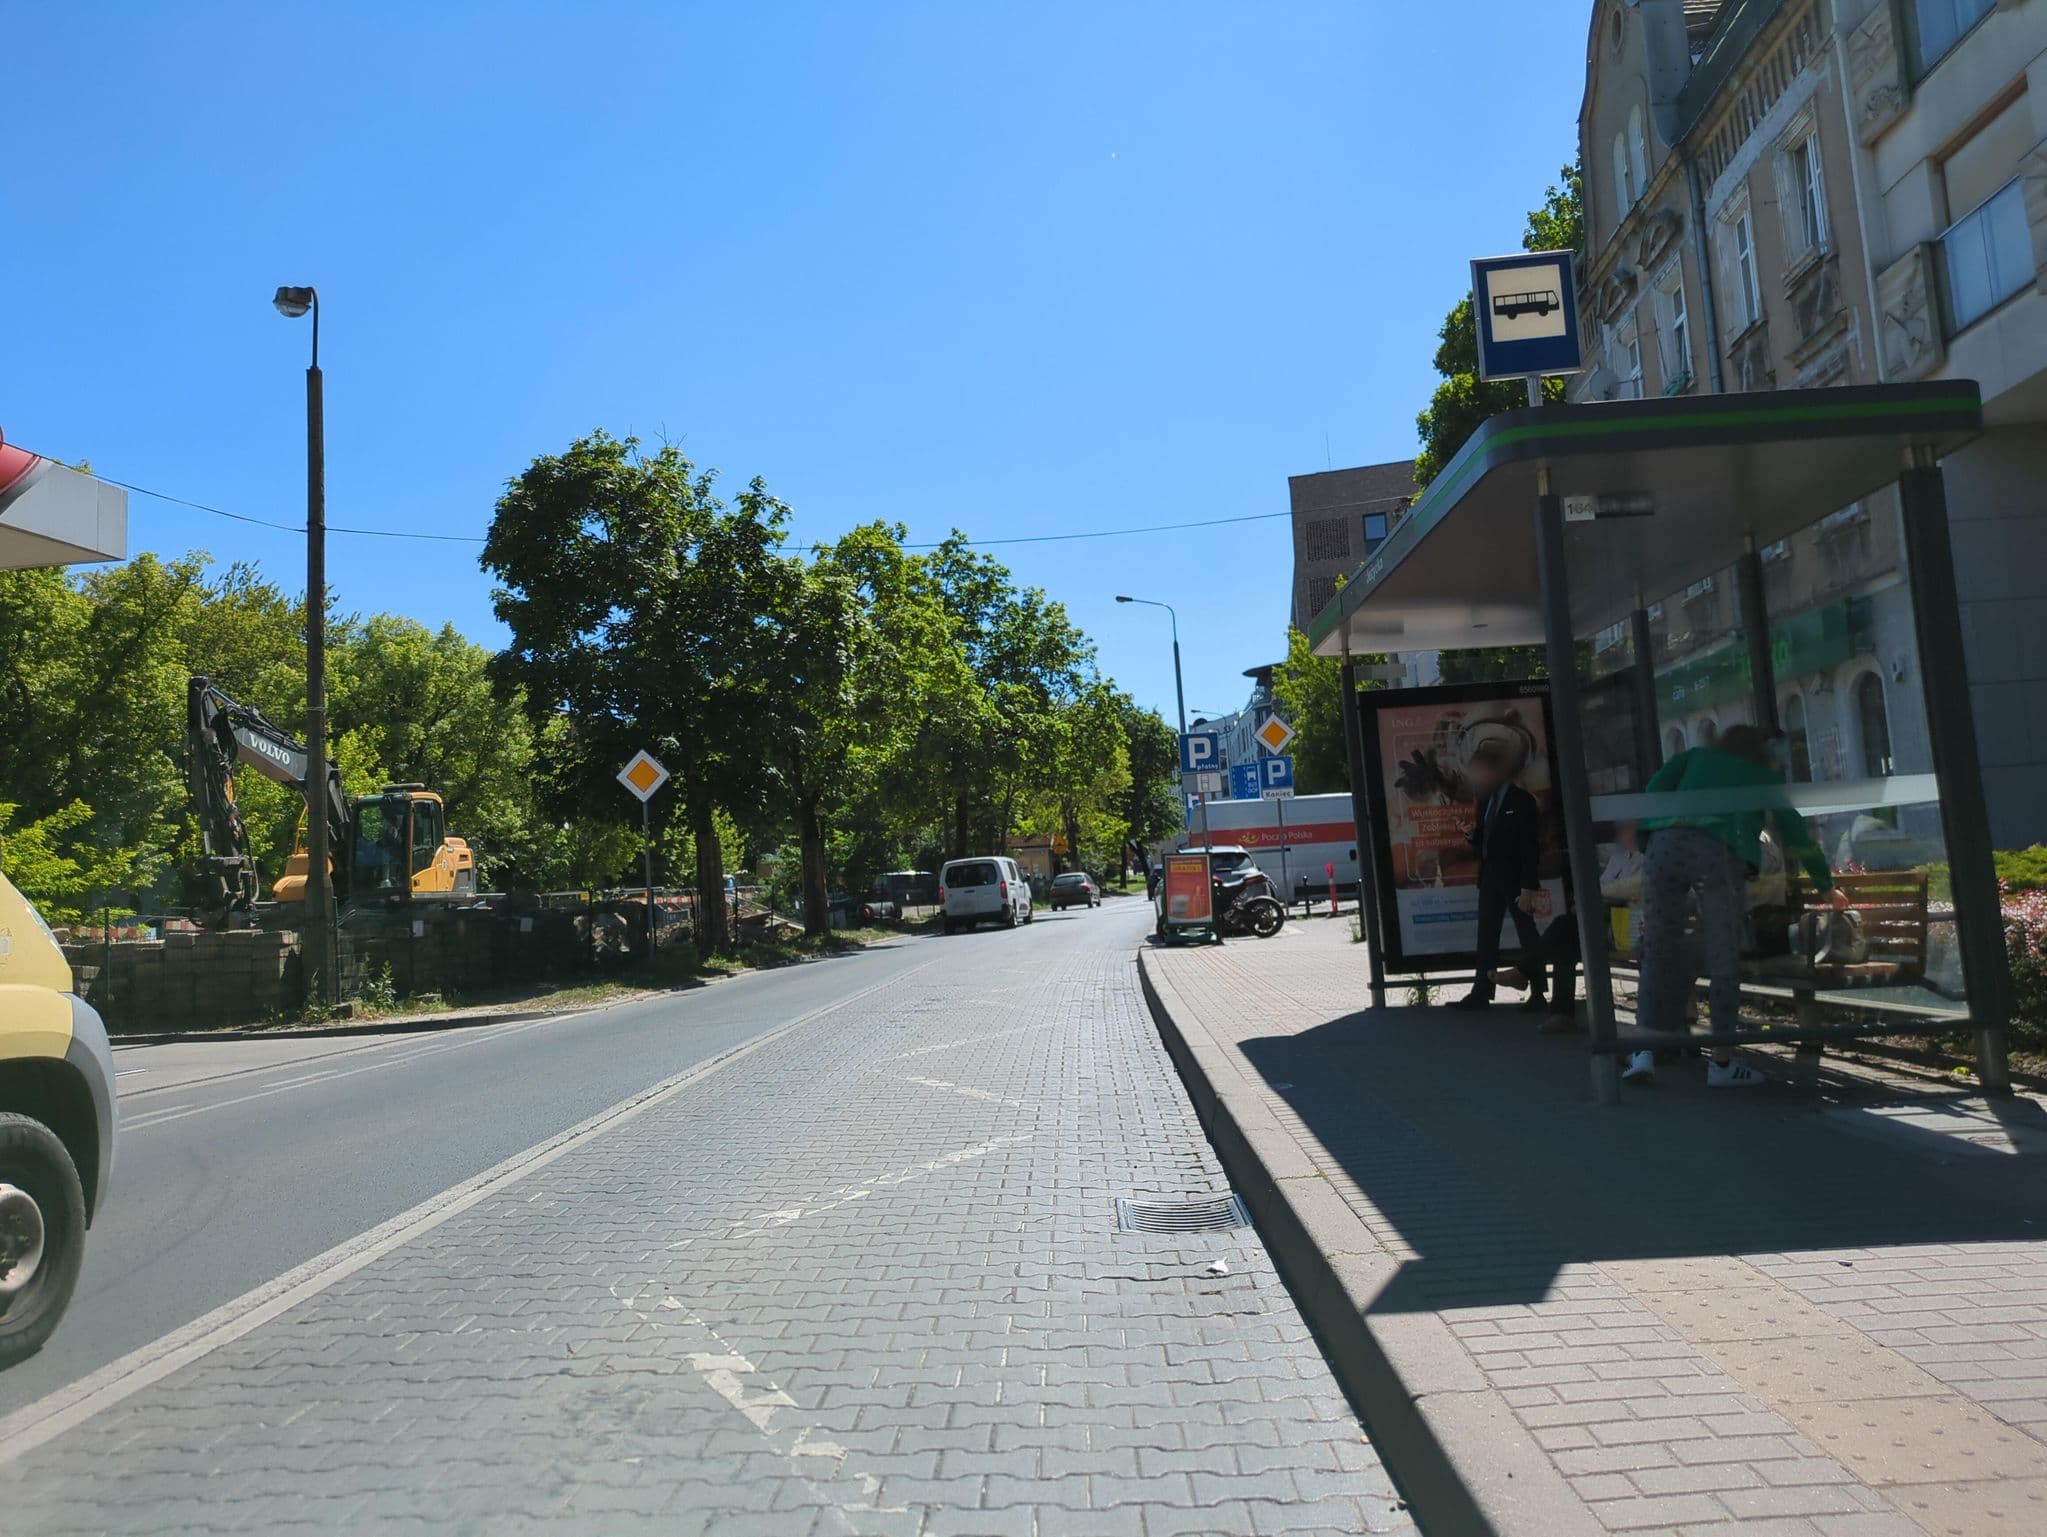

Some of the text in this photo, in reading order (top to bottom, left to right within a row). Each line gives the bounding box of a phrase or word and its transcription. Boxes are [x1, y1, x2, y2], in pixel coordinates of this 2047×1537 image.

[249, 732, 291, 765] VOLVO
[1188, 737, 1211, 768] P
[1267, 760, 1285, 784] P
[1288, 831, 1312, 840] Polska
